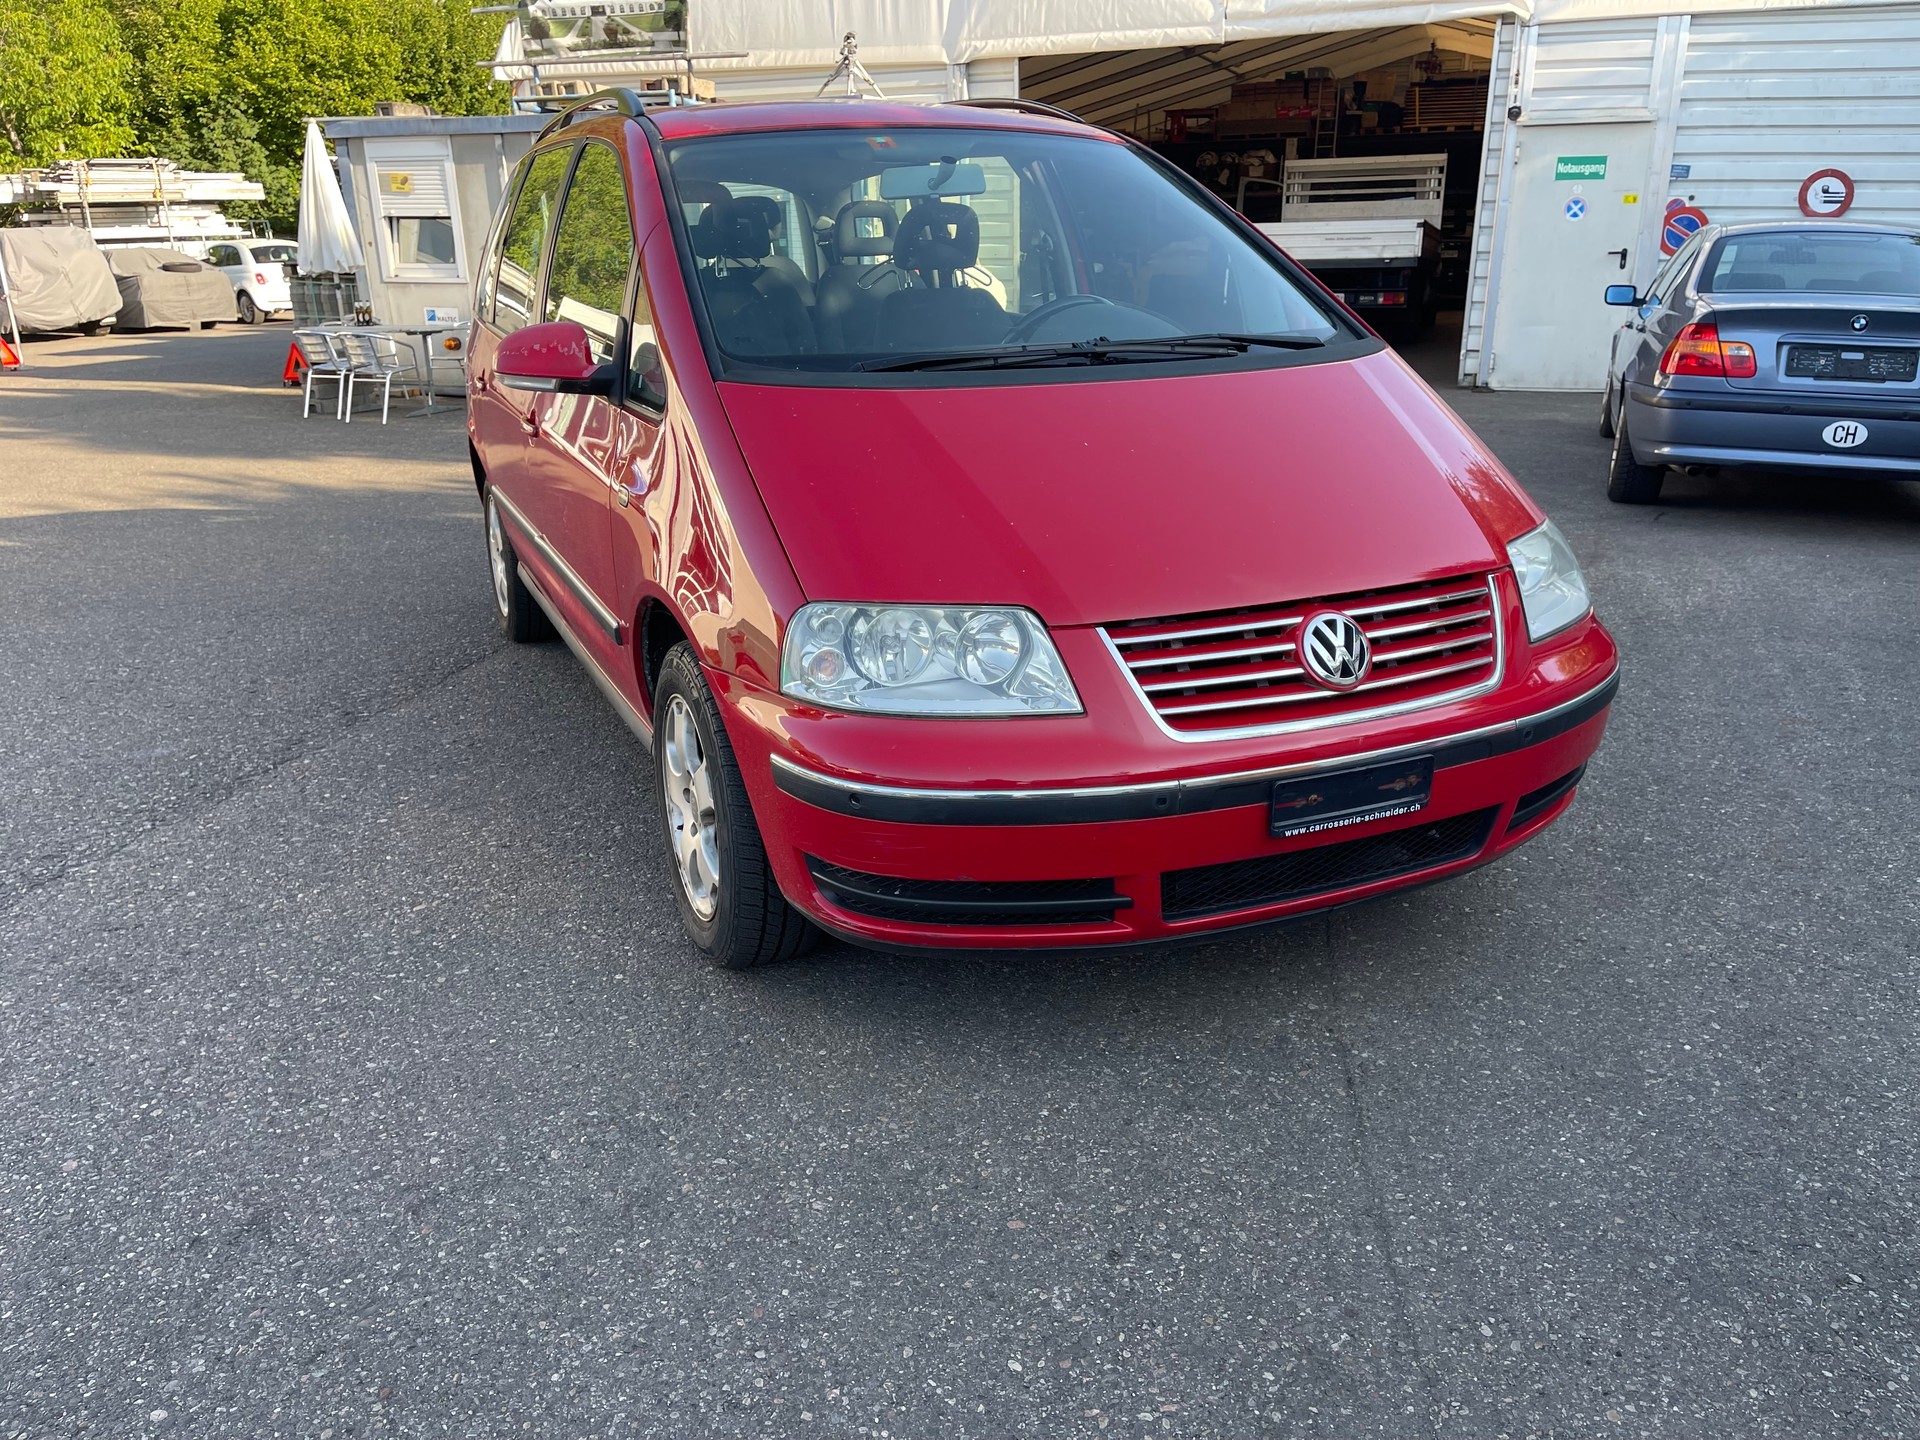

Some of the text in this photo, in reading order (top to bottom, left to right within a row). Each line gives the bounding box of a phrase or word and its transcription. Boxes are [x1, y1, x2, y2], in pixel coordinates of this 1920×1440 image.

[1557, 163, 1606, 175] Notausgang
[1832, 425, 1858, 444] CH
[1303, 613, 1369, 685] VW
[1285, 803, 1421, 837] www.carrosserie-schneider.ch
